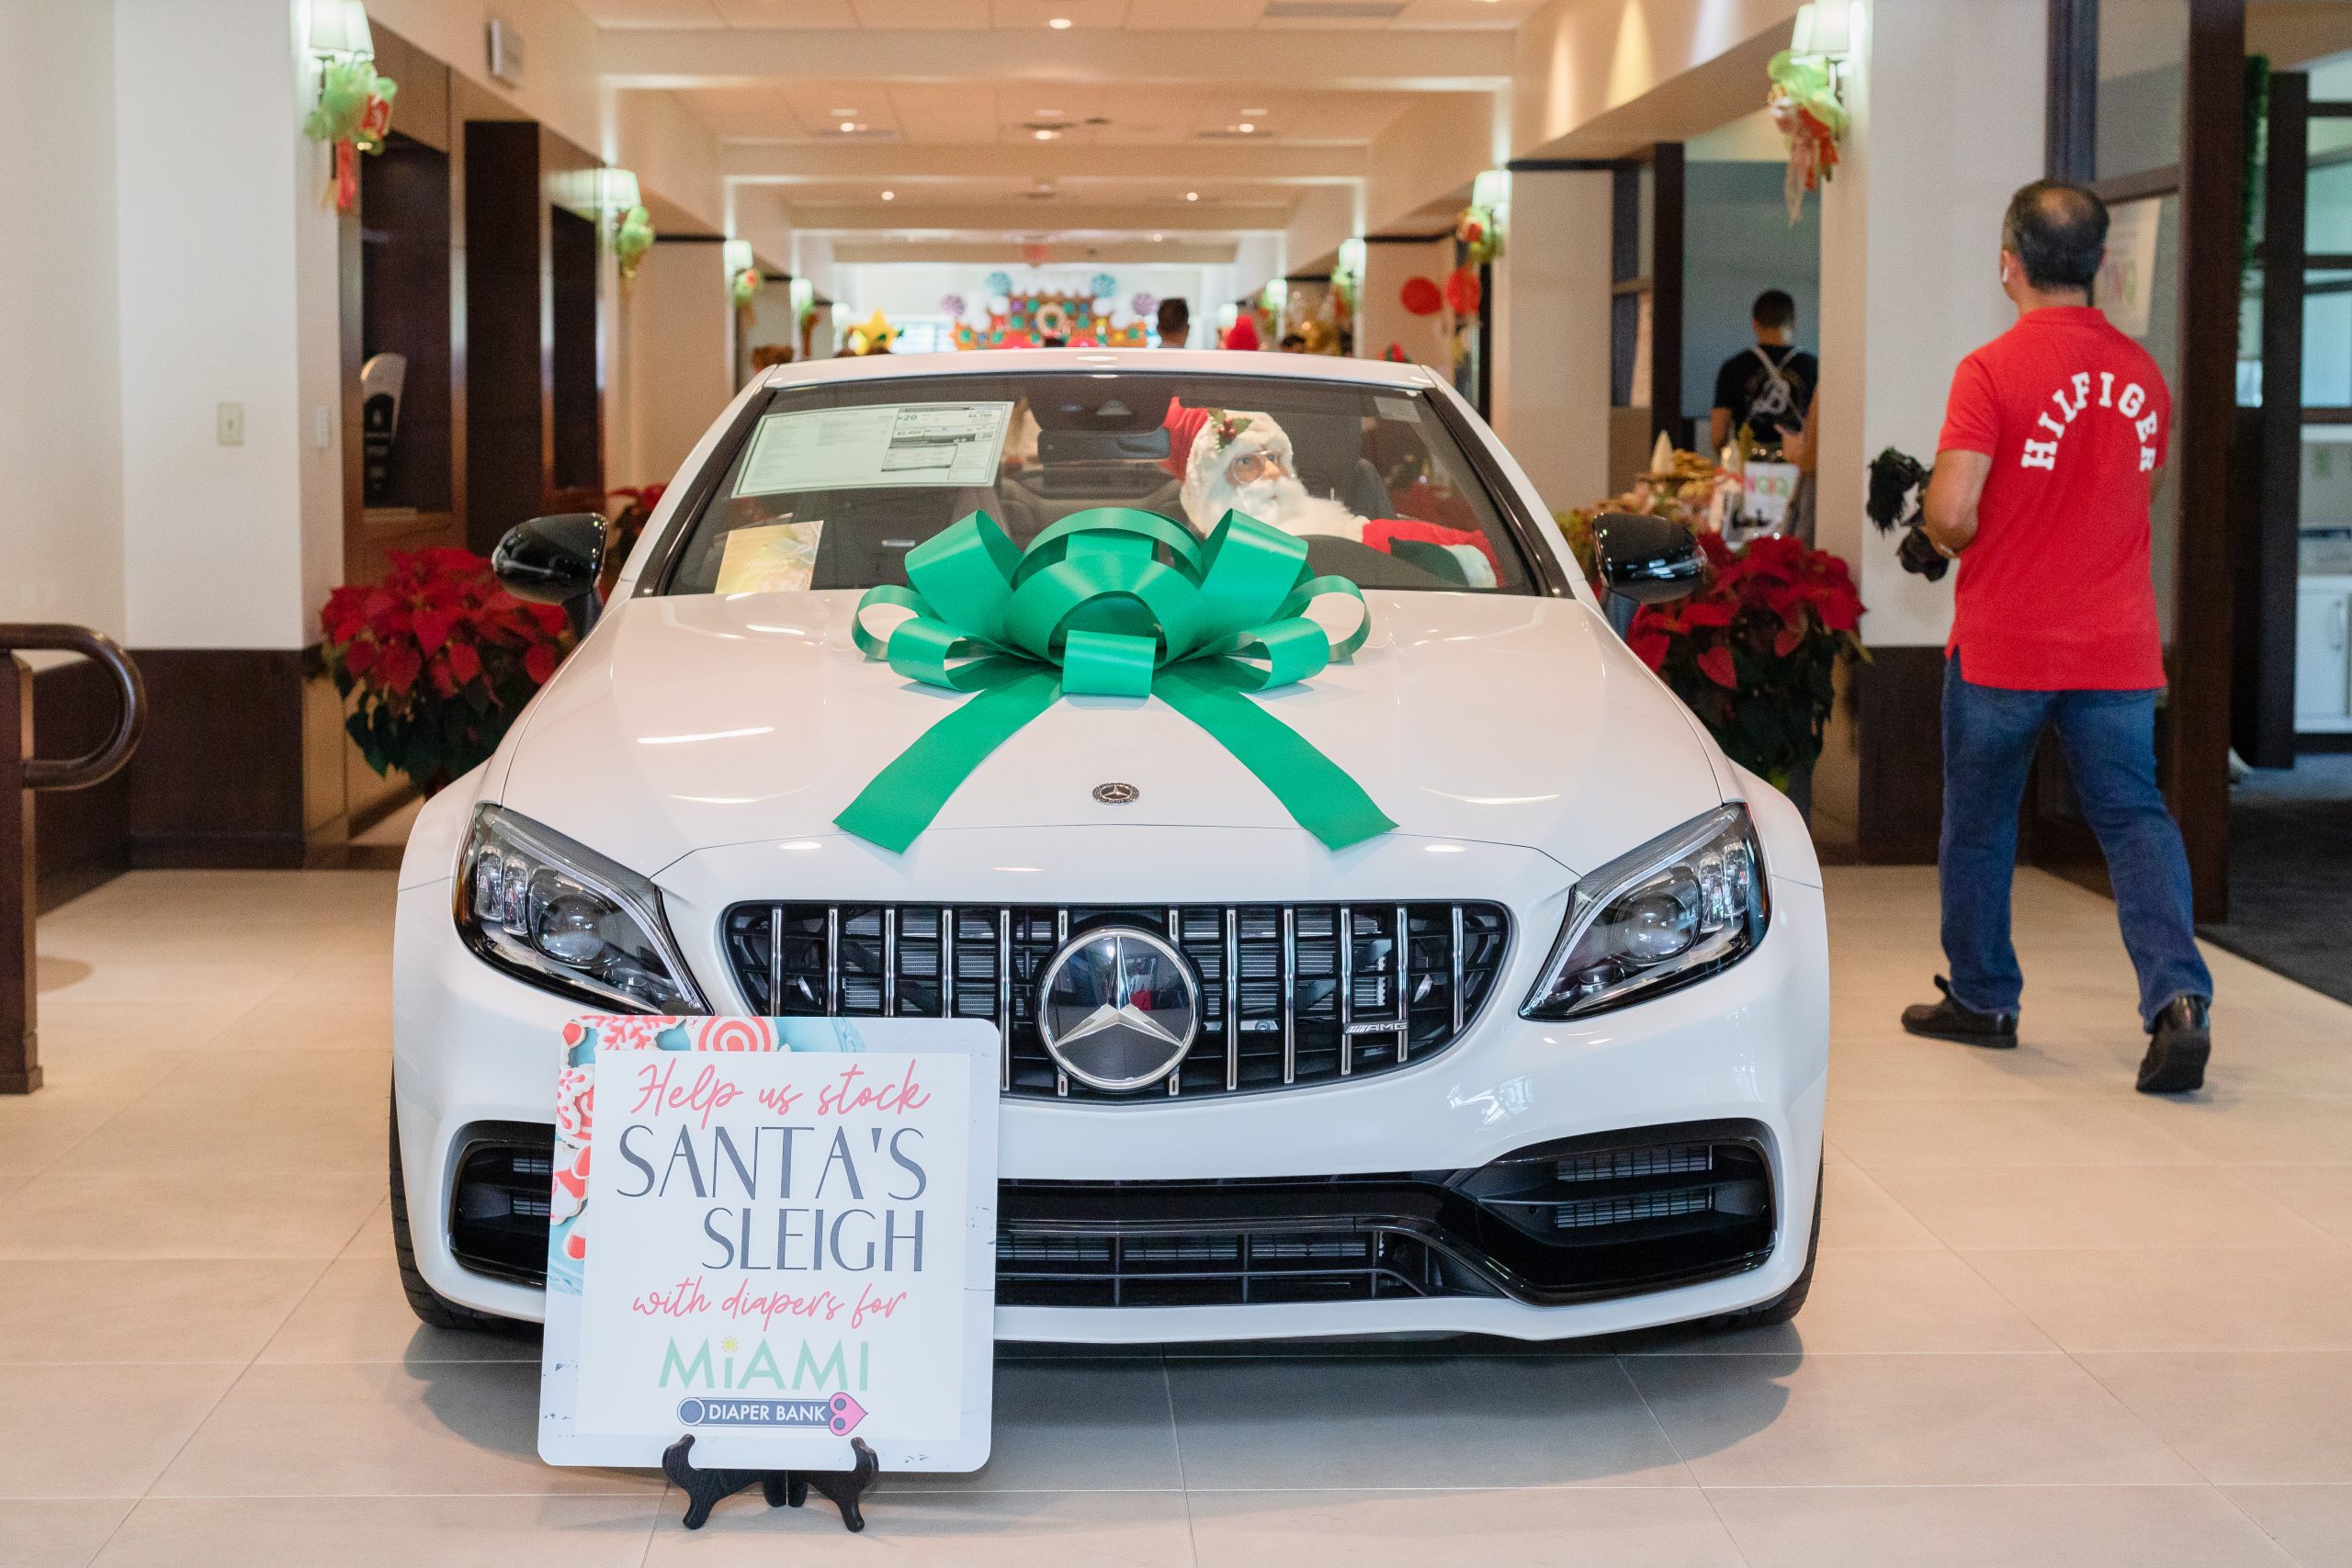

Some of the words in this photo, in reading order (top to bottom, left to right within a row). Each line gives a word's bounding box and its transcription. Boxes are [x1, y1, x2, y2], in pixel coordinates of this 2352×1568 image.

[2021, 371, 2158, 472] HILFIGER
[1365, 1022, 1408, 1032] AMG
[631, 1058, 743, 1130] Help
[758, 1082, 804, 1116] us
[817, 1059, 932, 1116] stock
[616, 1123, 927, 1201] SANTA'S
[702, 1207, 924, 1272] SLEIGH
[633, 1275, 712, 1318] with
[721, 1278, 845, 1332] diapers
[851, 1282, 908, 1330] for
[708, 1404, 770, 1420] DIAPER
[775, 1405, 826, 1422] BANK
